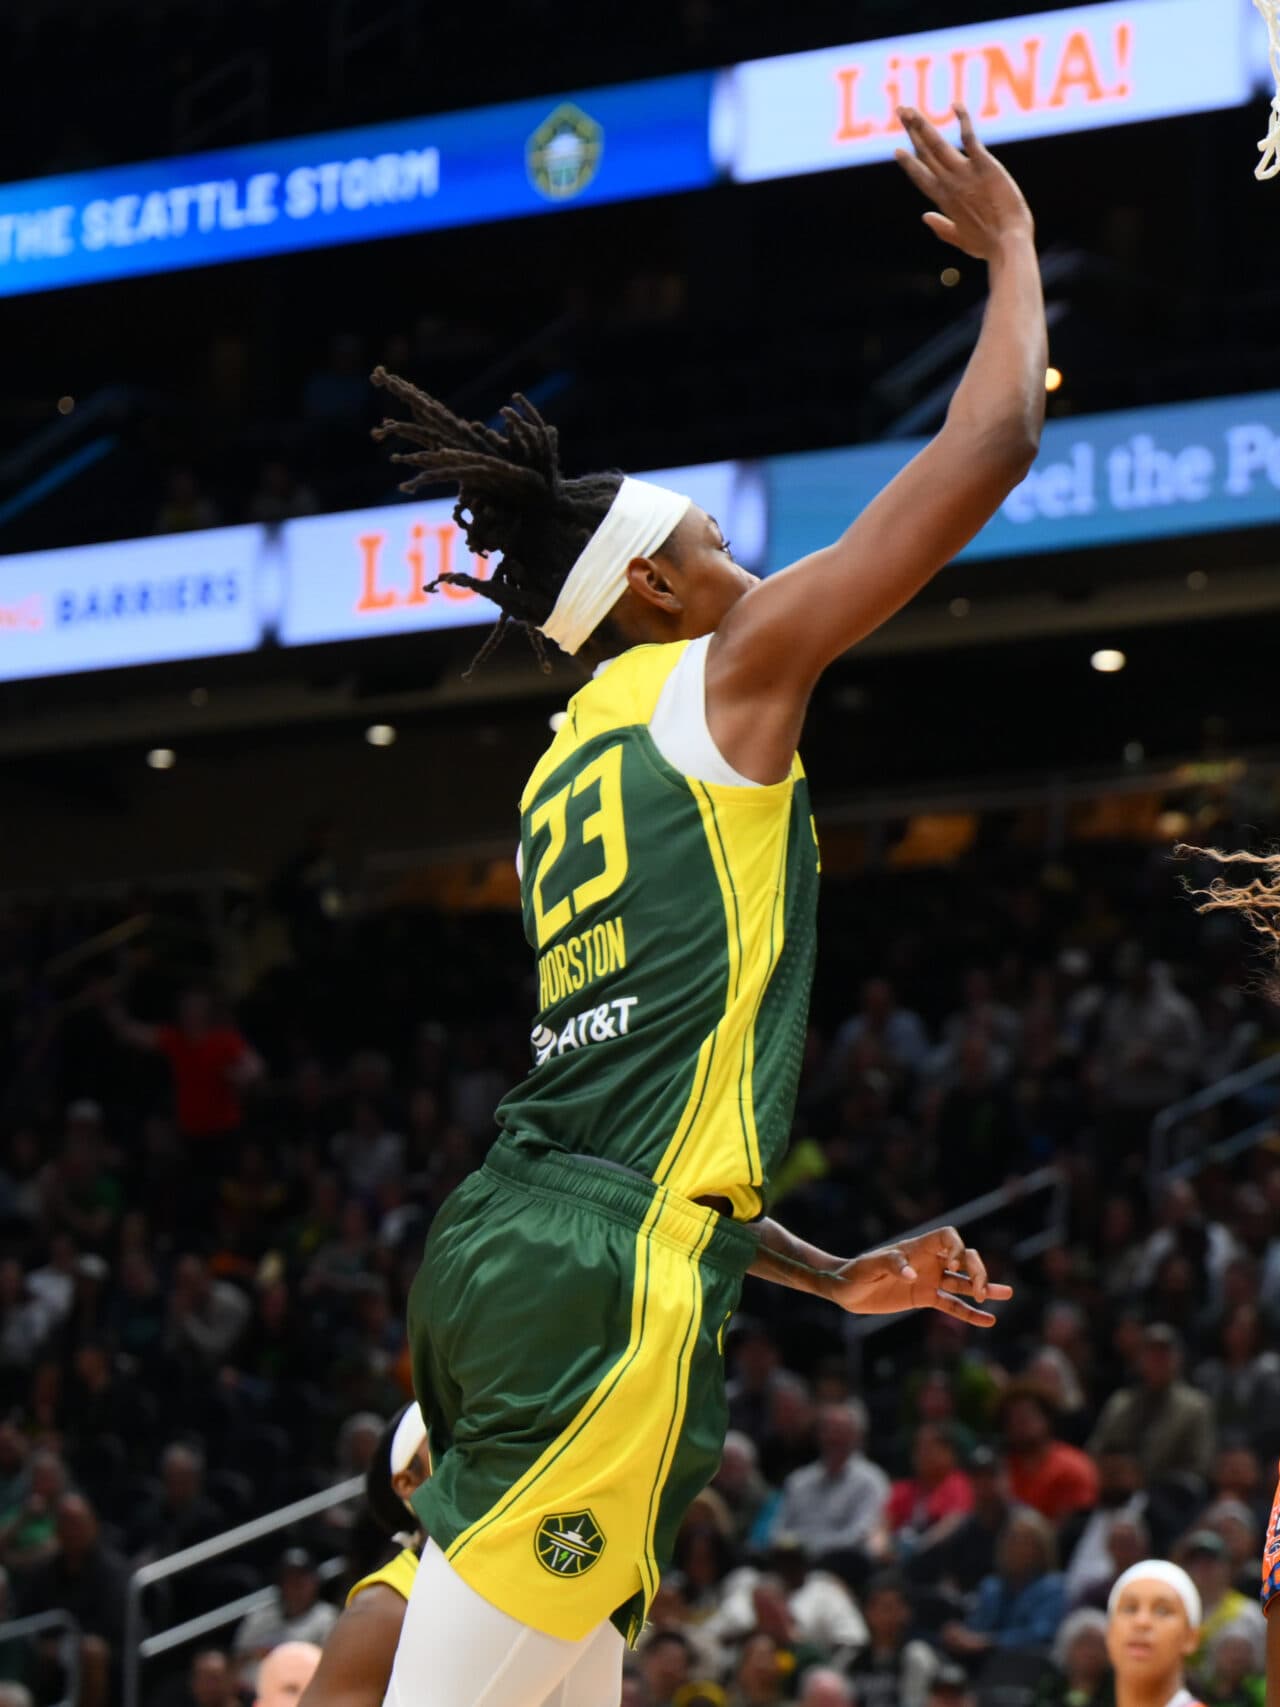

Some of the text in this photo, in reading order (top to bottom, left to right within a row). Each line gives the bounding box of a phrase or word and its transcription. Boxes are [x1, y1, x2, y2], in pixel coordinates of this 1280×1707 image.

[837, 24, 1128, 141] LiUNA!
[0, 146, 440, 265] THE SEATTLE STORM
[1002, 441, 1094, 523] eel
[1107, 433, 1213, 511] the
[55, 571, 238, 629] BARRIERS
[530, 744, 628, 950] 23
[538, 916, 627, 1013] HORSTON
[558, 997, 639, 1055] AT&T
